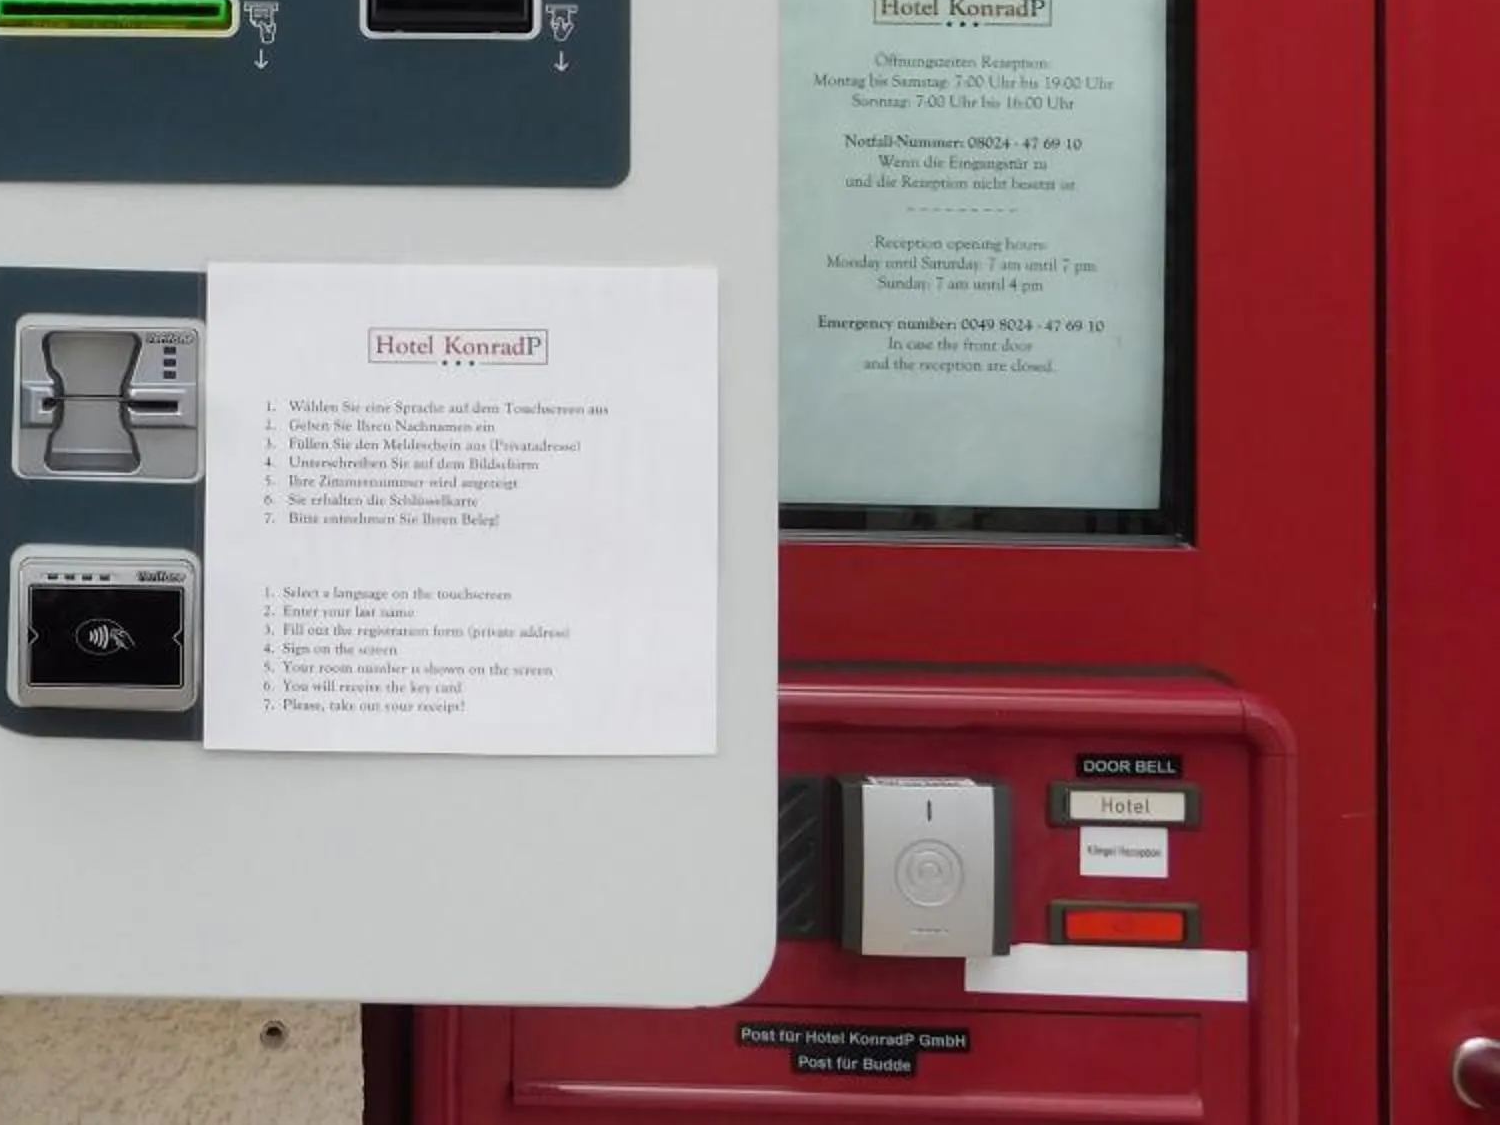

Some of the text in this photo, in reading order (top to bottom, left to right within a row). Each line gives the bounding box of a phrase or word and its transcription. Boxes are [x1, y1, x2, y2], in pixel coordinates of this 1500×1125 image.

[1066, 139, 1082, 151] 10
[818, 315, 893, 331] Emergency
[1088, 319, 1104, 333] 10
[375, 336, 542, 357] Hotel KonradP
[1083, 759, 1176, 774] DOOR BELL
[1102, 797, 1151, 814] Hotel
[741, 1028, 966, 1048] Post für Hotel KonradP GmbH
[798, 1056, 911, 1073] Post für Budde
